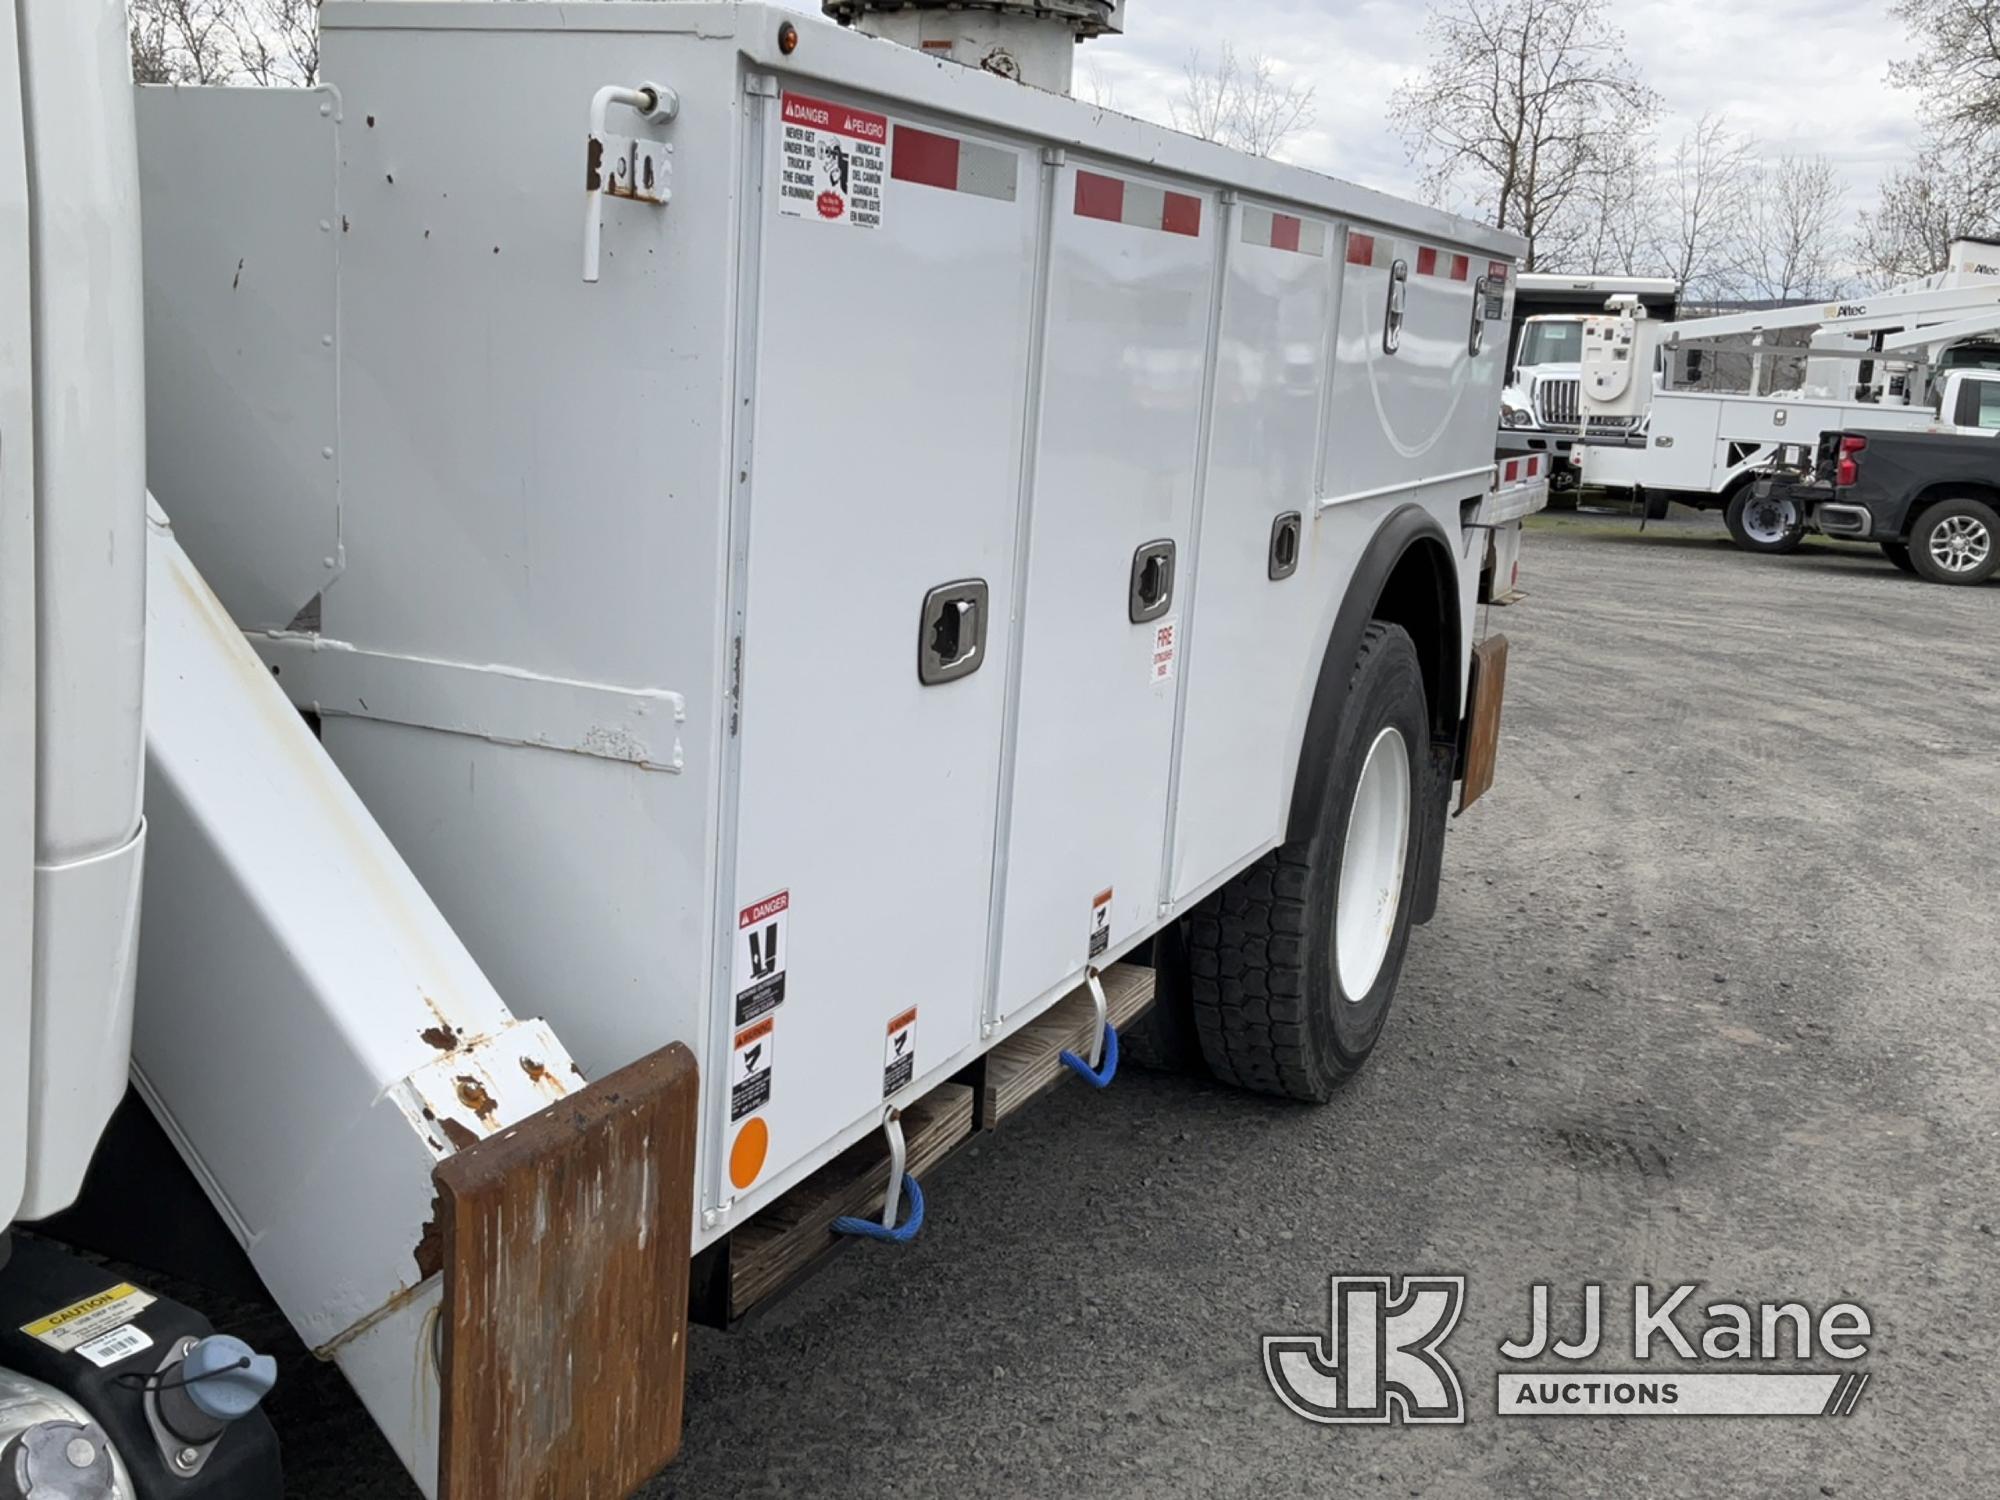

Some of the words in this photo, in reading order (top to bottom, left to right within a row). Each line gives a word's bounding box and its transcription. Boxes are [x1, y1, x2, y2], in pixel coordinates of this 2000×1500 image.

[794, 104, 829, 125] DANGER
[786, 127, 803, 140] NEVER
[805, 130, 815, 143] GET
[853, 118, 884, 138] PELIGRO
[784, 141, 802, 155] UNDER
[803, 144, 816, 158] THIS
[787, 156, 805, 170] TRUCK
[806, 160, 812, 171] IF
[783, 170, 793, 183] THE
[794, 173, 814, 186] ENGINE
[852, 169, 861, 181] DEL
[850, 211, 857, 222] EN
[1974, 263, 1999, 276] Altec
[1837, 305, 1867, 318] Altec
[1157, 625, 1173, 648] FIRE
[753, 895, 787, 921] DANGER
[49, 1293, 114, 1325] CAUTION
